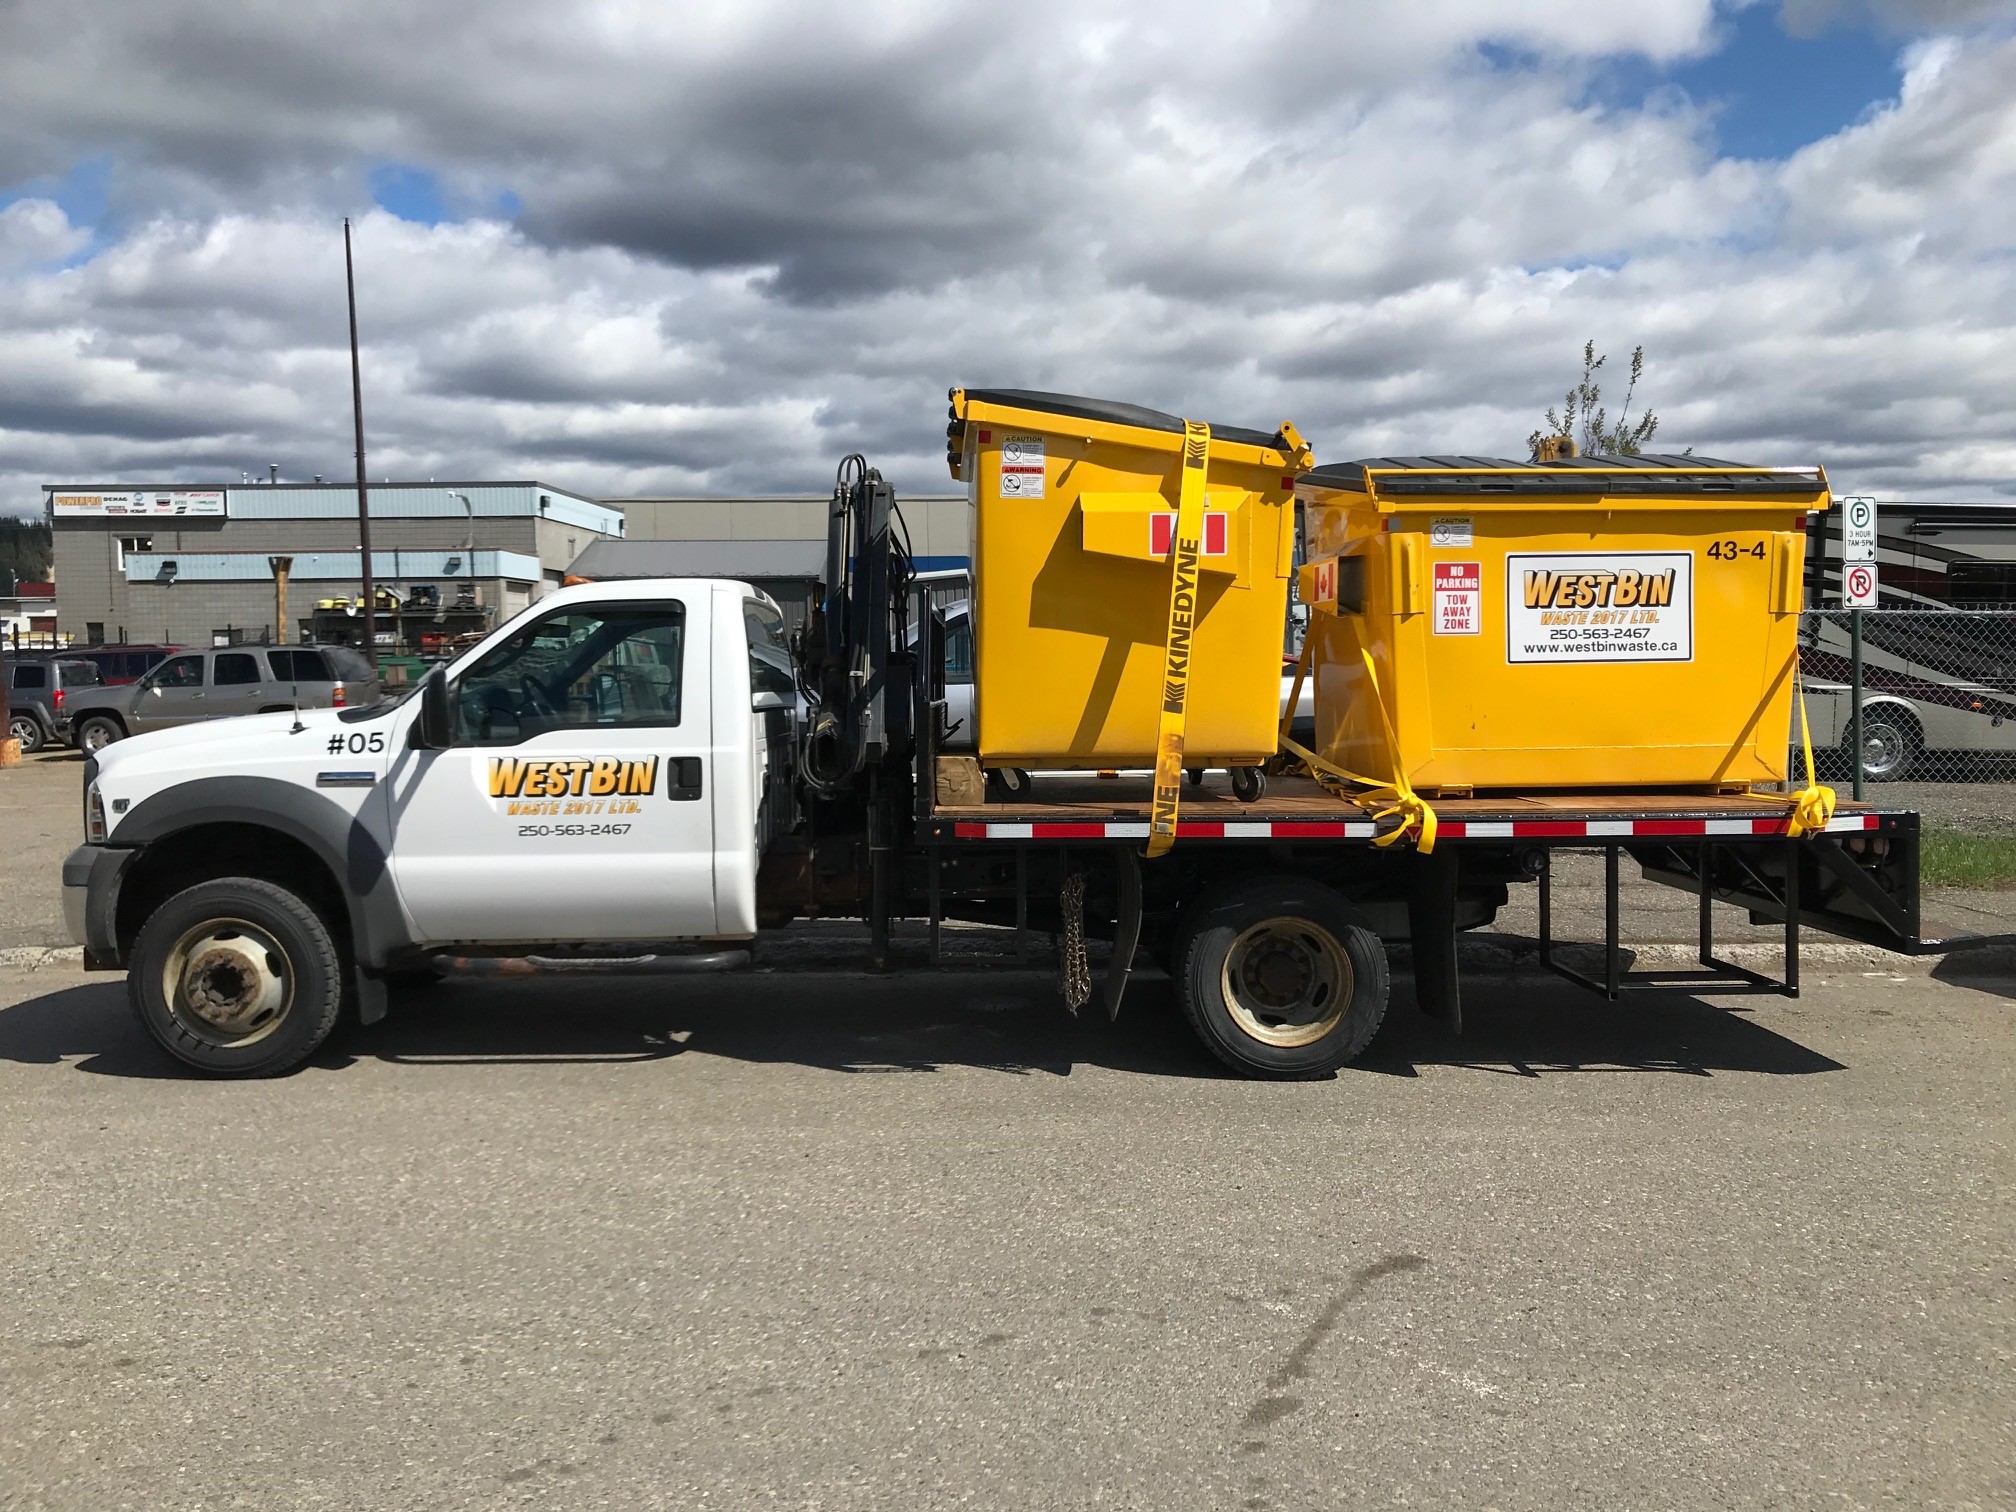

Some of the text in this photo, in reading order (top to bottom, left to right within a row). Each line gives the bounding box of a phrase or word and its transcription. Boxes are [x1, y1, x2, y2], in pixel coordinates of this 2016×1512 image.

[1847, 539, 1874, 547] 7AM-5PM
[1707, 541, 1766, 560] 43-4
[1450, 566, 1464, 576] NO
[1436, 578, 1478, 589] PARKING
[1446, 594, 1468, 605] TOW
[1167, 537, 1199, 679] KINEDYNE
[1443, 606, 1471, 617] AWAY
[1444, 618, 1470, 629] ZONE
[1540, 610, 1660, 626] WASTE 2017 LTD.
[1550, 628, 1651, 640] 250-563-2467
[1524, 640, 1678, 654] www.westbinwaste.ca
[327, 732, 385, 755] #05
[506, 799, 642, 816] WASTE 2017 LTD.
[518, 824, 632, 837] 250-563-2467
